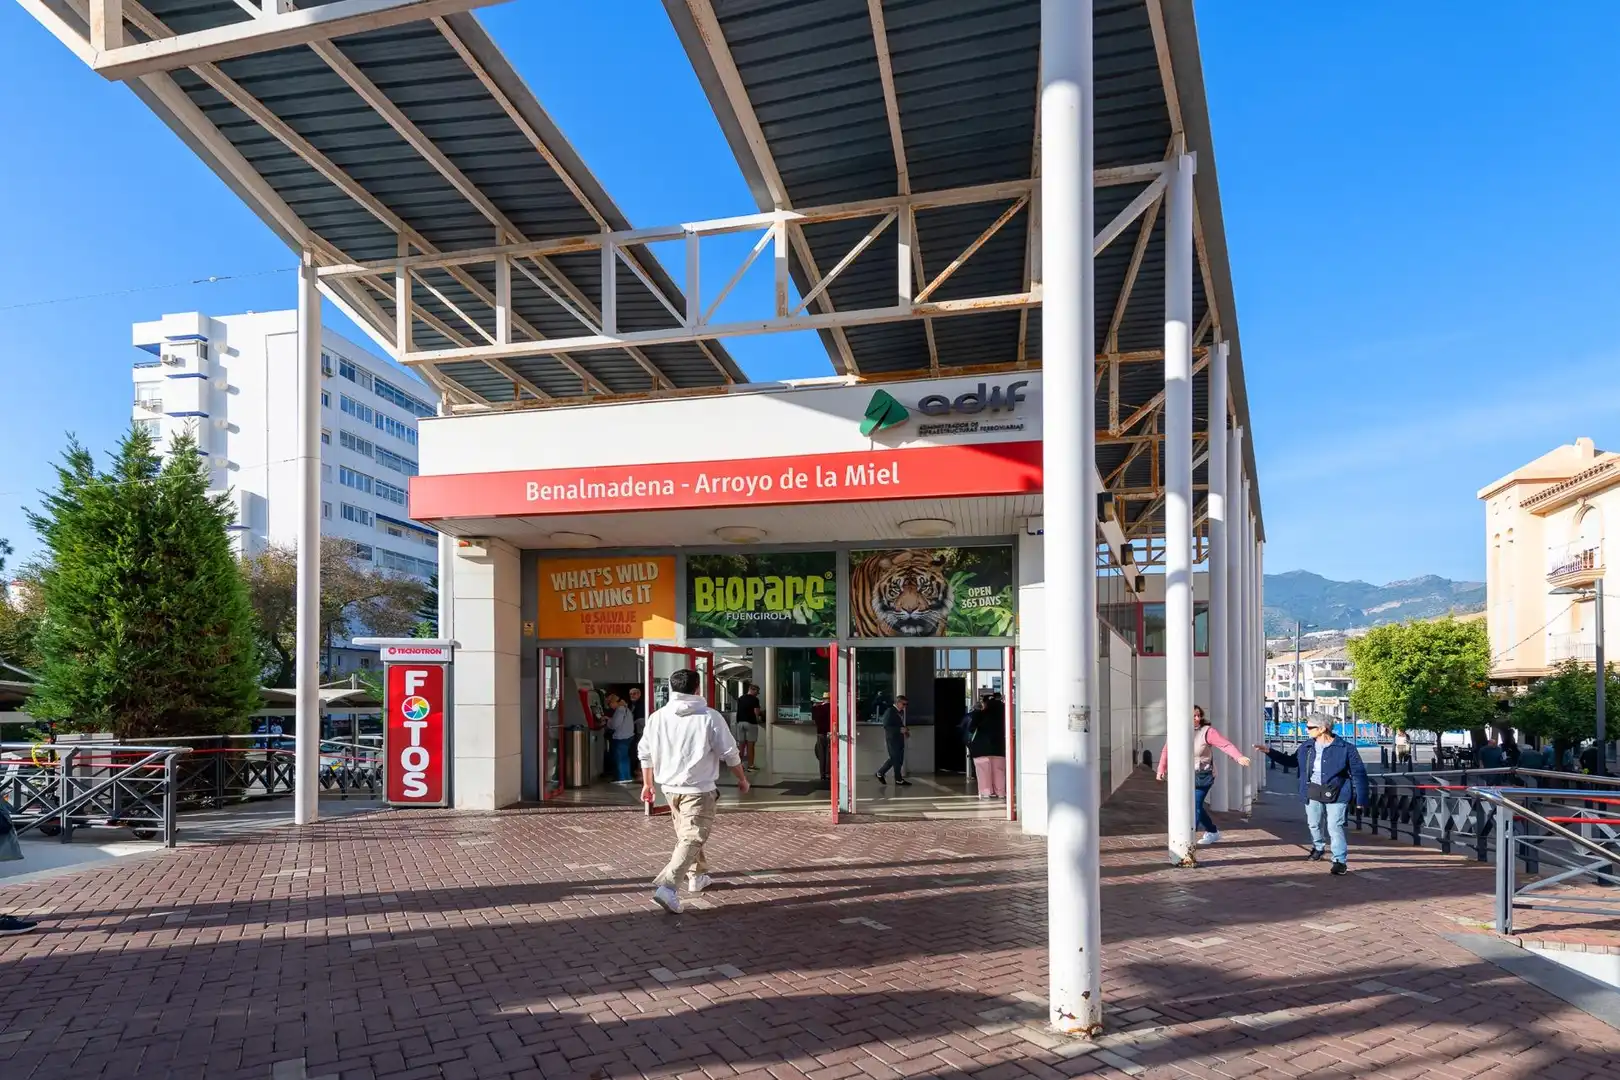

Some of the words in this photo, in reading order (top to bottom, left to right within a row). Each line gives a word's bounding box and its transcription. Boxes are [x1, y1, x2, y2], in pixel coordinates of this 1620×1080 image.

[918, 380, 1029, 416] adif
[980, 423, 1025, 432] FERROVIARIAS
[526, 476, 675, 501] Benalmadena
[695, 473, 773, 497] Arroyo
[779, 467, 808, 489] de
[816, 465, 837, 487] la
[844, 462, 900, 487] Miel
[551, 566, 613, 592] WHAT'S
[616, 562, 659, 584] WILD
[562, 592, 577, 612] IS
[580, 587, 633, 610] LIVING
[636, 584, 652, 603] IT
[968, 586, 992, 597] OPEN
[961, 599, 978, 609] 365
[979, 596, 1002, 607] DAYS
[580, 611, 591, 624] LO
[593, 611, 637, 623] SALVAJE
[726, 612, 792, 621] FUENGIROLA
[585, 624, 596, 635] ES
[597, 623, 632, 635] VIVIRLO
